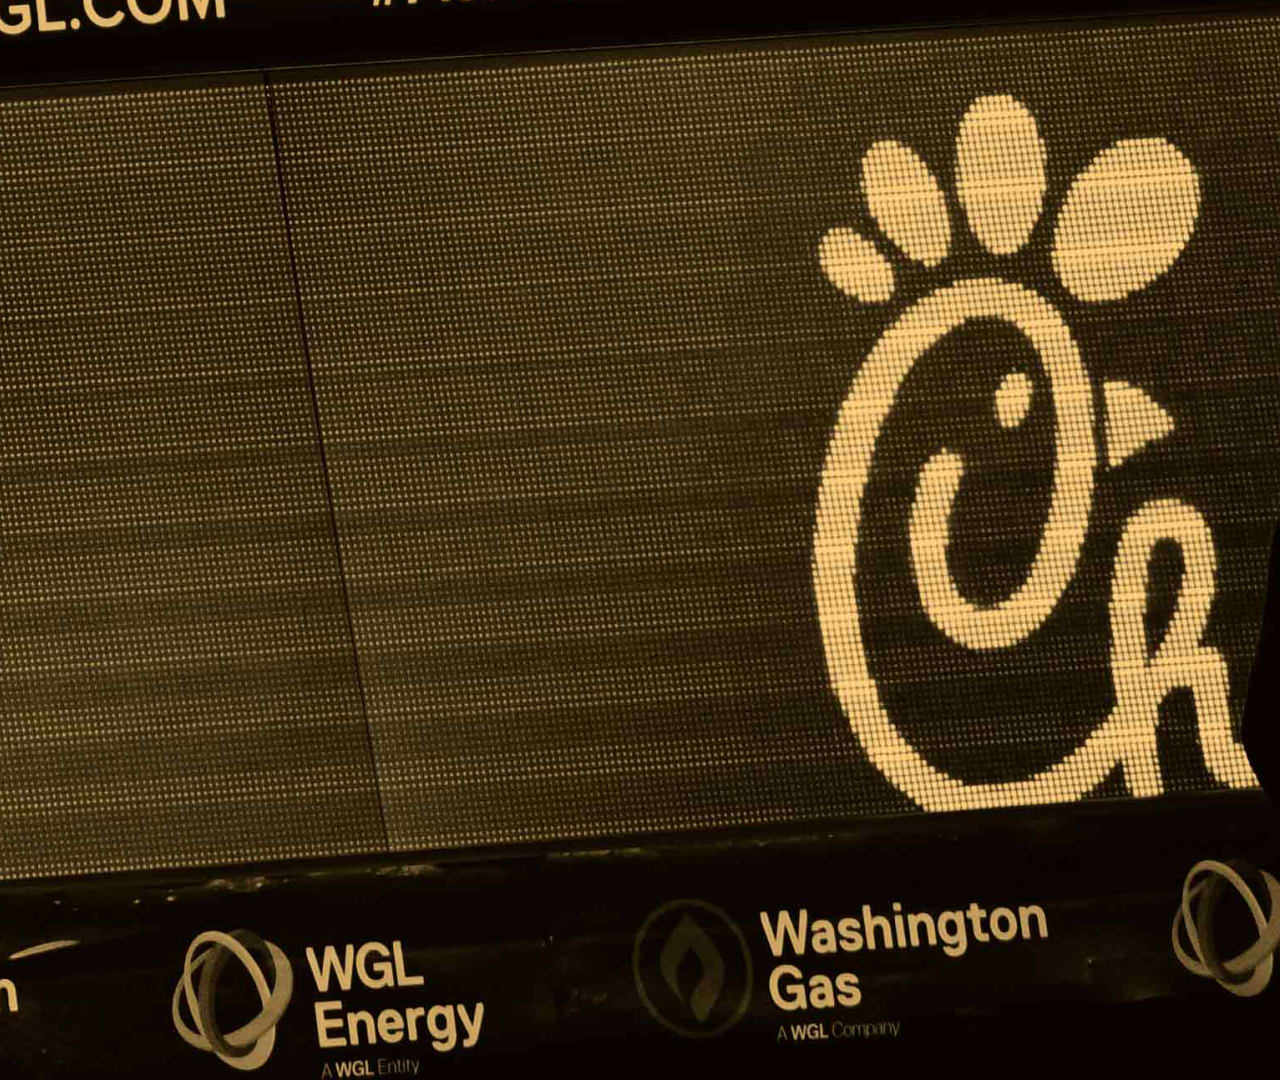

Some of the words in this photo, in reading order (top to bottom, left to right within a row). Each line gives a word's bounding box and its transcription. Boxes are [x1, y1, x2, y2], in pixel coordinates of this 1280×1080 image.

[759, 901, 1049, 958] Washington
[305, 940, 425, 994] WGL
[768, 964, 863, 1011] Gas
[314, 1000, 485, 1052] Energy
[790, 1023, 829, 1041] WGL
[831, 1019, 901, 1040] Company
[335, 1059, 375, 1078] WGL
[377, 1056, 421, 1075] Entity
